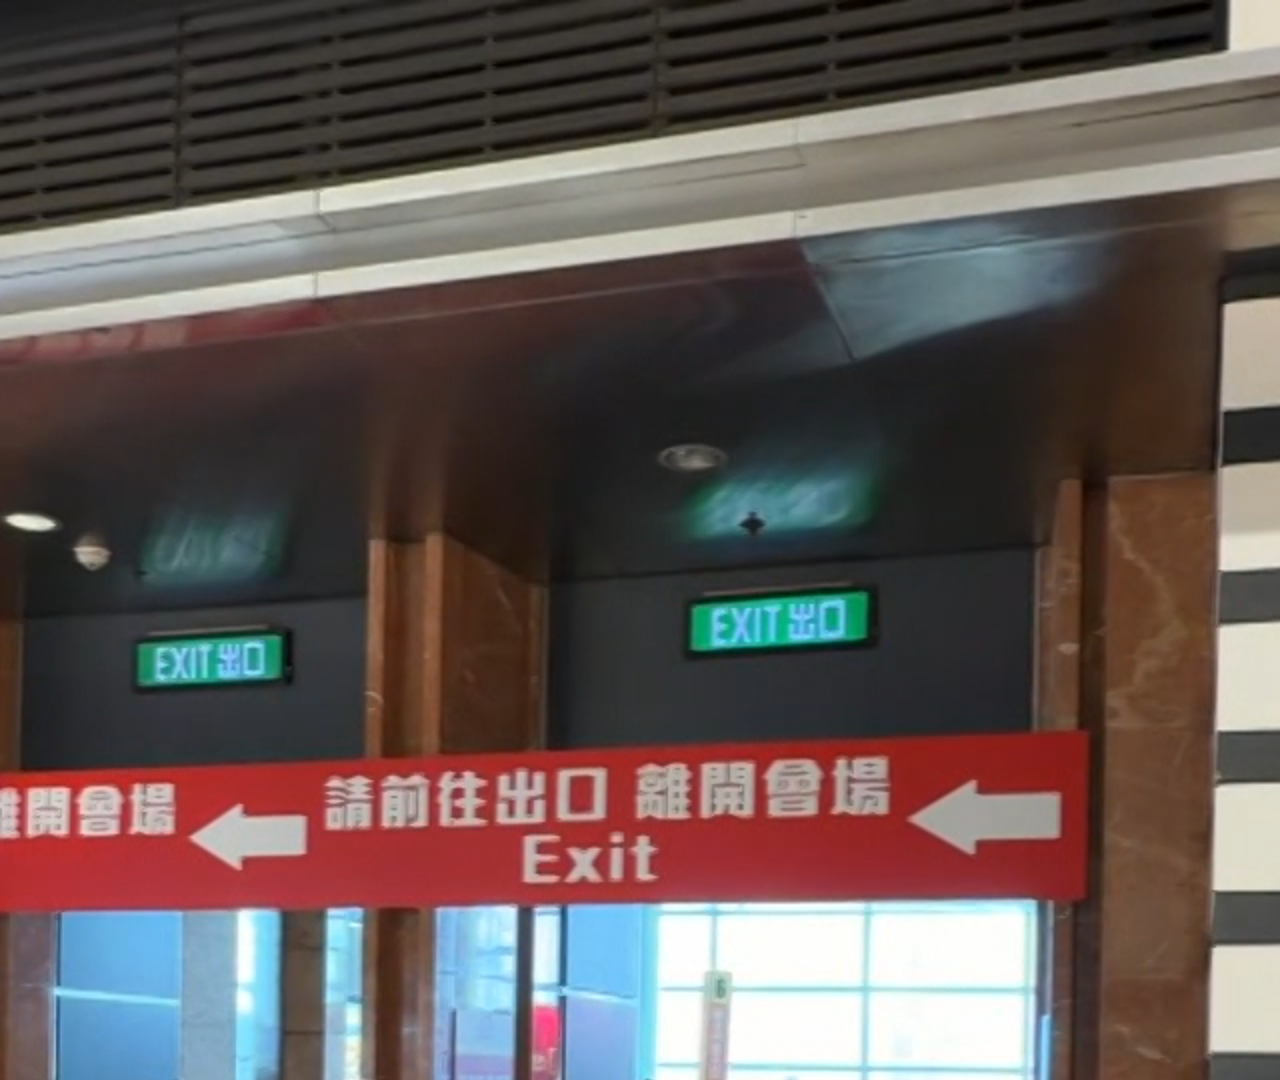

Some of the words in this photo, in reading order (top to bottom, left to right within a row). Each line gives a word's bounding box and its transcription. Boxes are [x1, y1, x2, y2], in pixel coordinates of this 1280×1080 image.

[711, 607, 780, 647] EXIT
[789, 599, 846, 640] 出口
[156, 643, 211, 680] EXIT
[218, 641, 265, 678] 出口
[325, 766, 608, 831] 請前往出口
[634, 755, 890, 821] 離開會場
[522, 832, 658, 883] Exit
